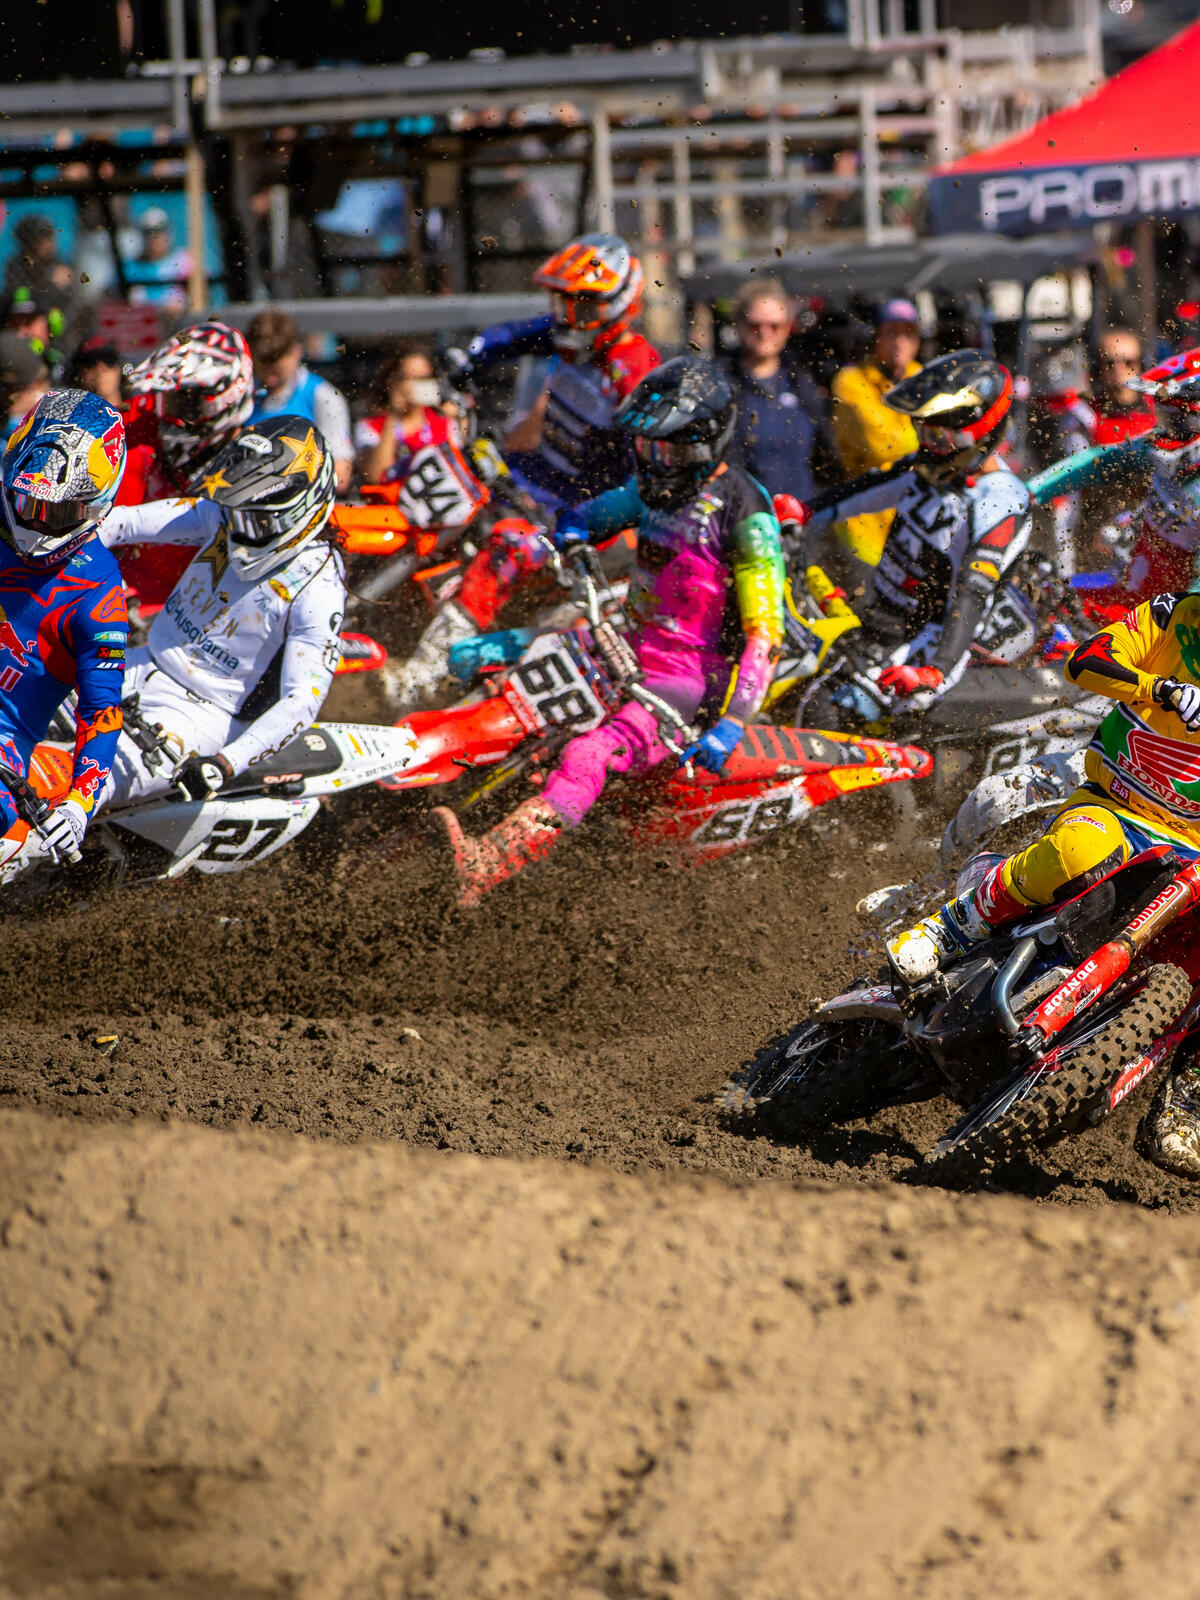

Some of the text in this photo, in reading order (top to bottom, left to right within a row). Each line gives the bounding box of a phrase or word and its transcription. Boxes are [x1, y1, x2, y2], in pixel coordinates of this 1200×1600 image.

[173, 607, 241, 670] Husqvarna
[184, 577, 239, 639] SEVEN
[517, 652, 597, 724] 68
[197, 818, 290, 862] 27
[1043, 960, 1098, 1016] DUNLOP
